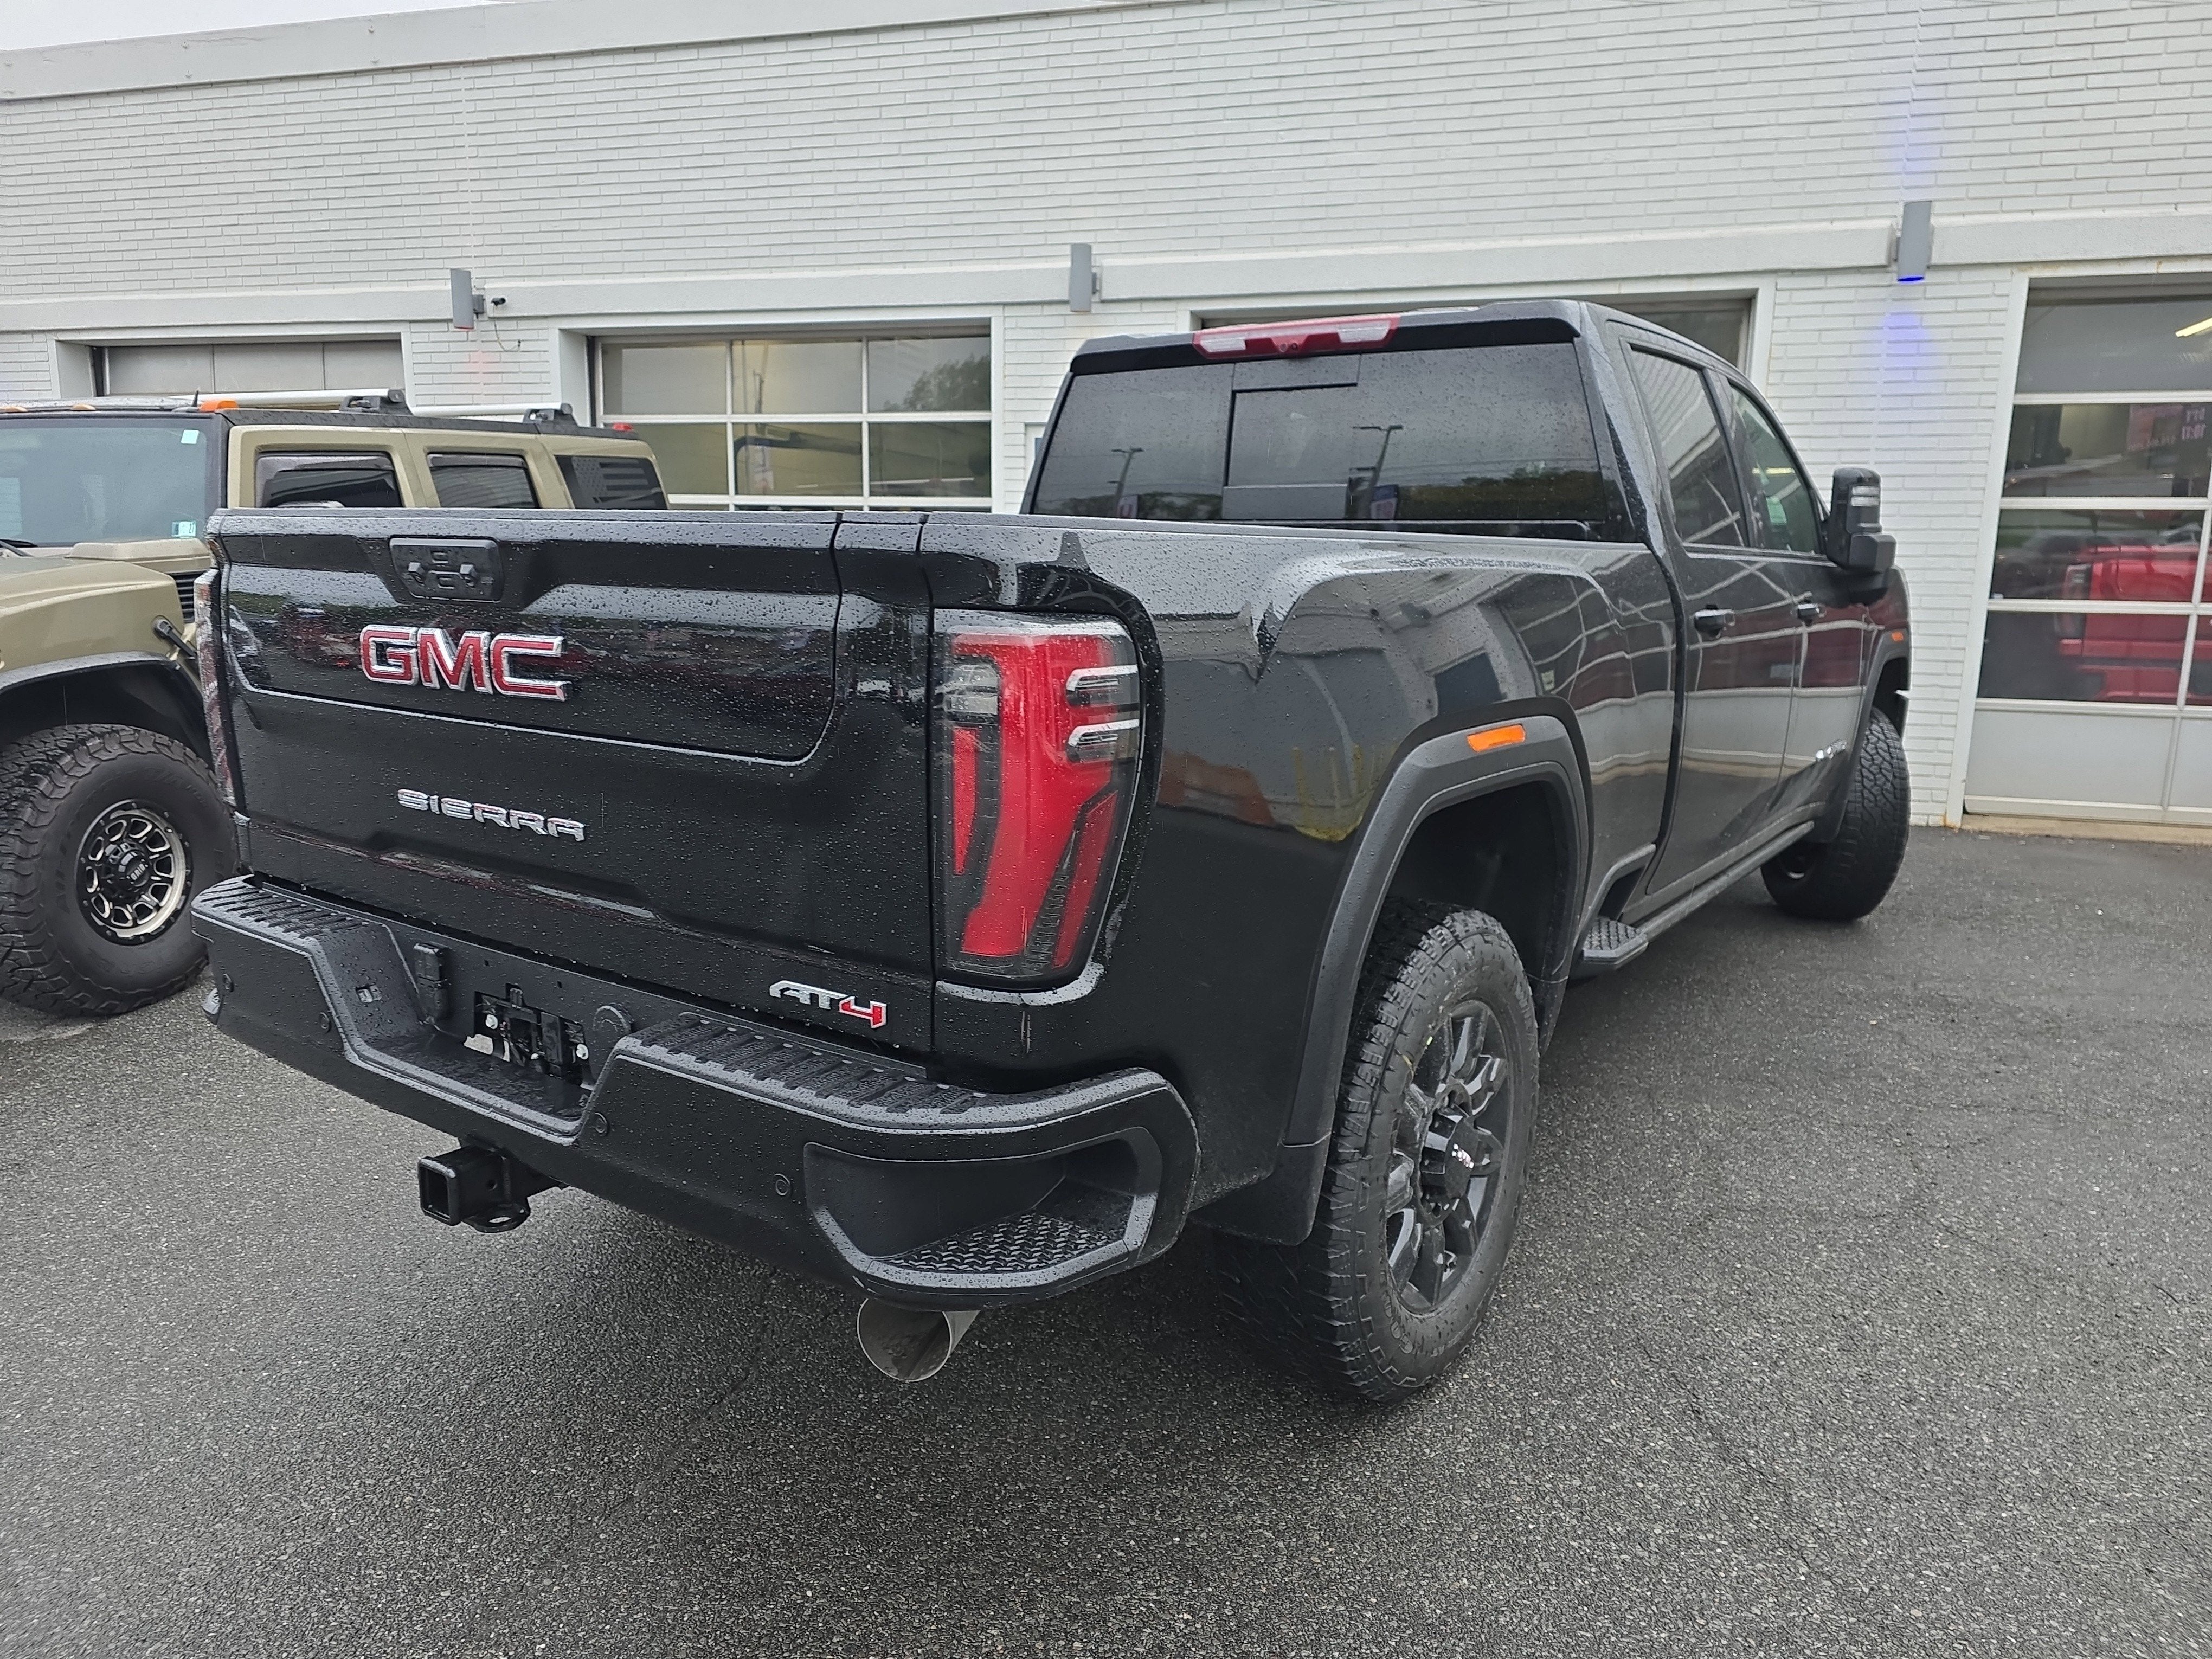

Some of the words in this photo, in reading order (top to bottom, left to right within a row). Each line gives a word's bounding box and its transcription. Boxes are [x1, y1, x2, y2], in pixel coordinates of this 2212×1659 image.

[360, 624, 572, 702] GMC
[397, 788, 585, 841] SIERRA
[130, 863, 145, 880] GRID
[769, 980, 887, 1029] AT4
